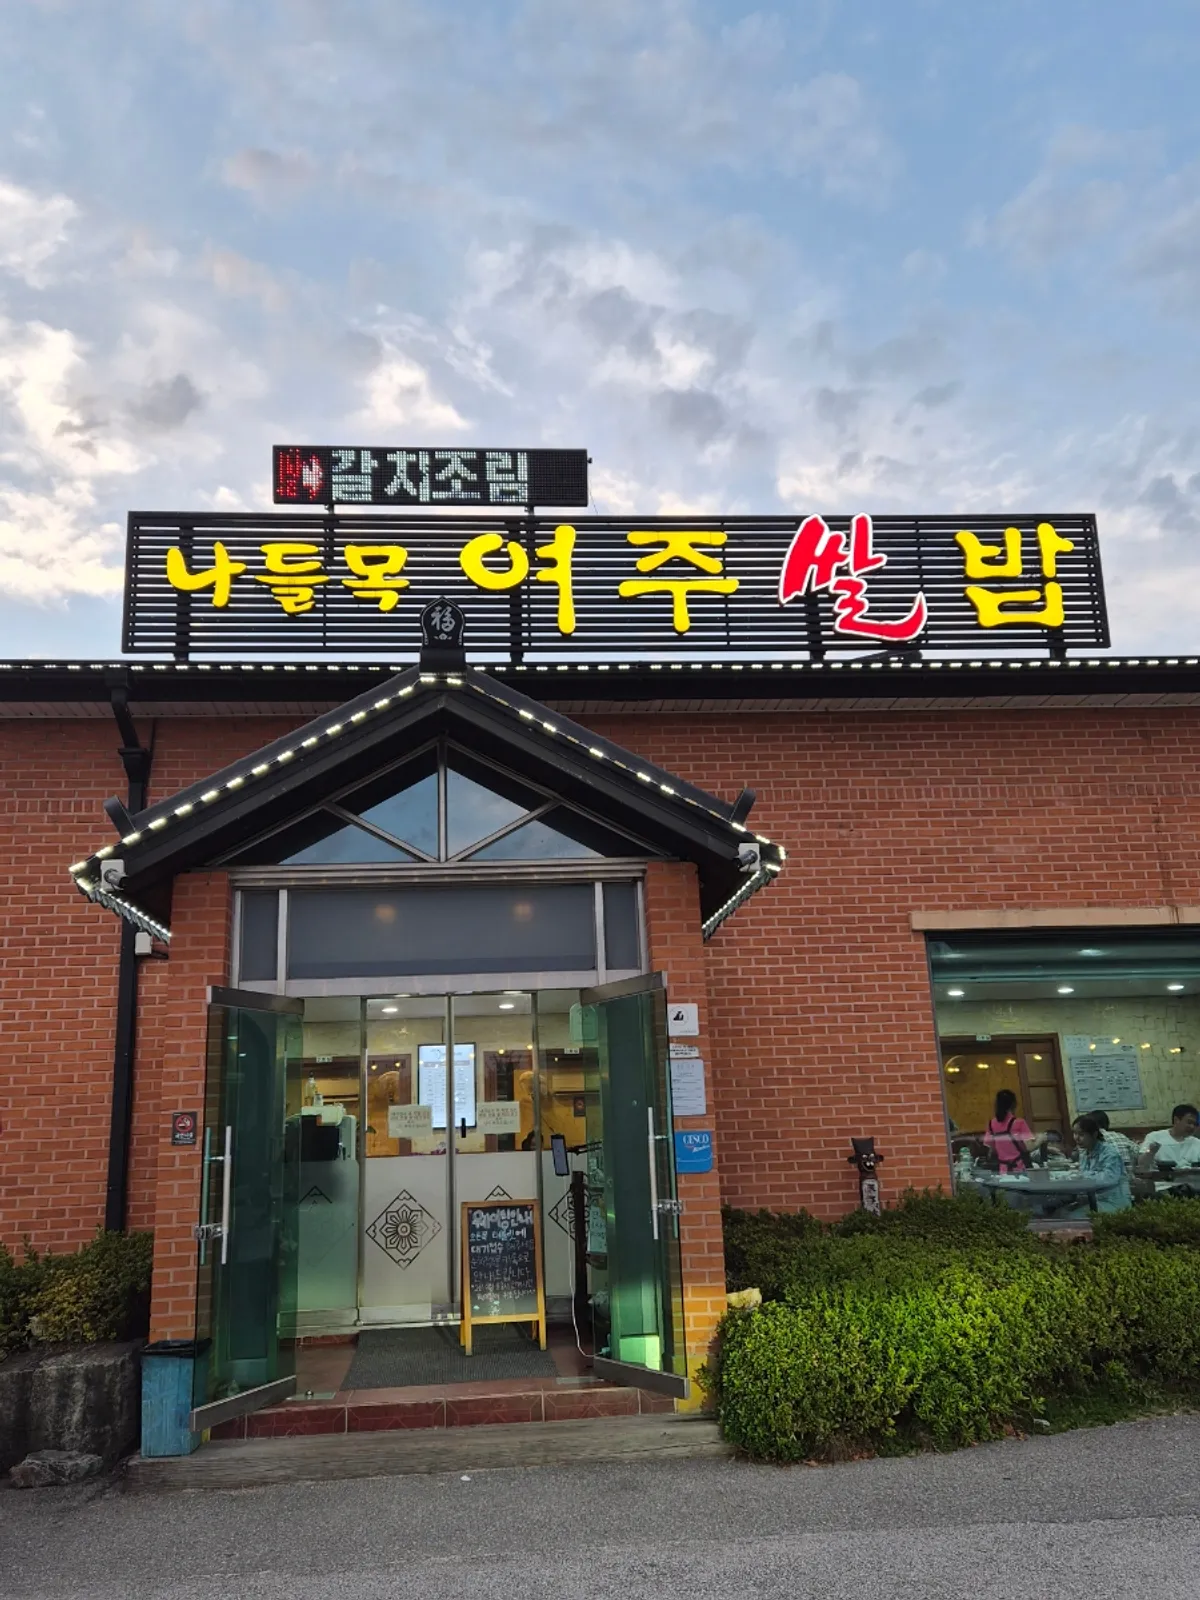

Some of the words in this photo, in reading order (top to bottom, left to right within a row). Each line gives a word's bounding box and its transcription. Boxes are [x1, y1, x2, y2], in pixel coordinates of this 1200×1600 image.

[331, 450, 528, 502] 갈치조림
[166, 541, 410, 615] 나들목
[431, 606, 456, 632] 福
